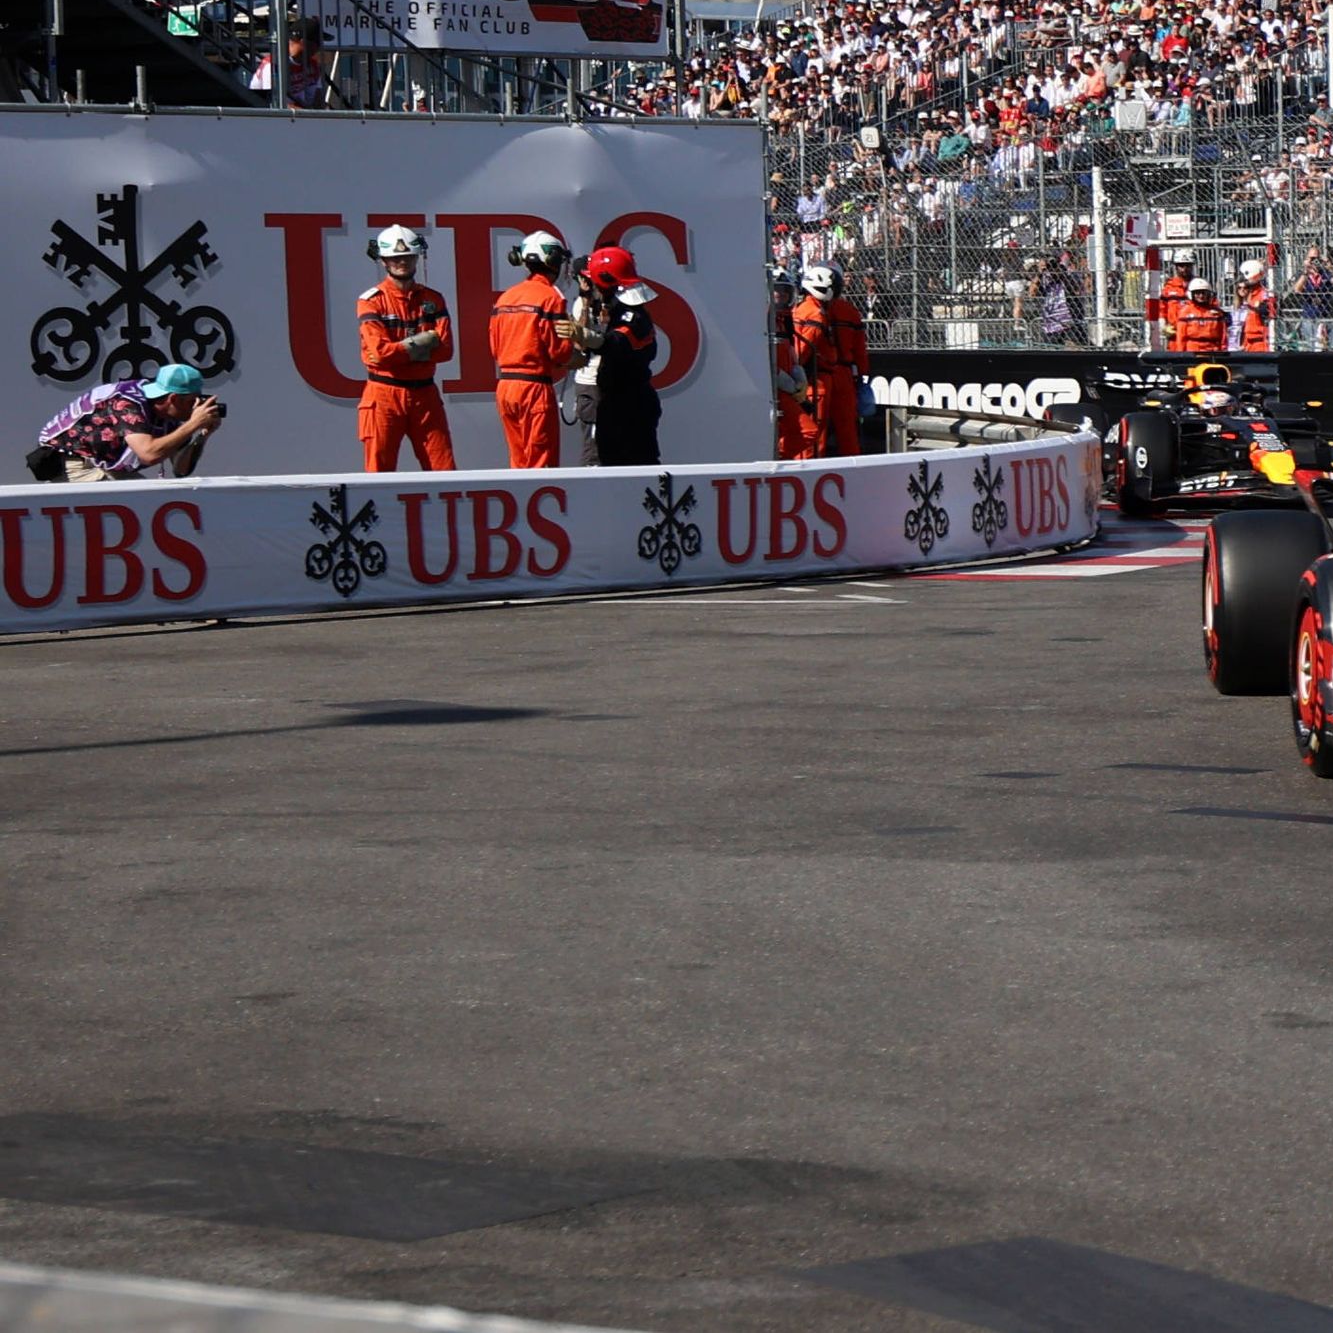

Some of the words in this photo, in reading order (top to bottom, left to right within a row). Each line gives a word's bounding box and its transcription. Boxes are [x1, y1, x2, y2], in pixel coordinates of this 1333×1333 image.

[355, 0, 394, 14] THE
[408, 1, 504, 18] OFFICIAL
[434, 18, 468, 33] FAN
[480, 21, 531, 35] CLUB
[264, 211, 701, 399] UBS
[862, 375, 1081, 421] MonacoGP
[397, 486, 571, 585] UBS
[711, 472, 848, 565] UBS
[1010, 454, 1070, 538] UBS
[0, 500, 207, 608] UBS
